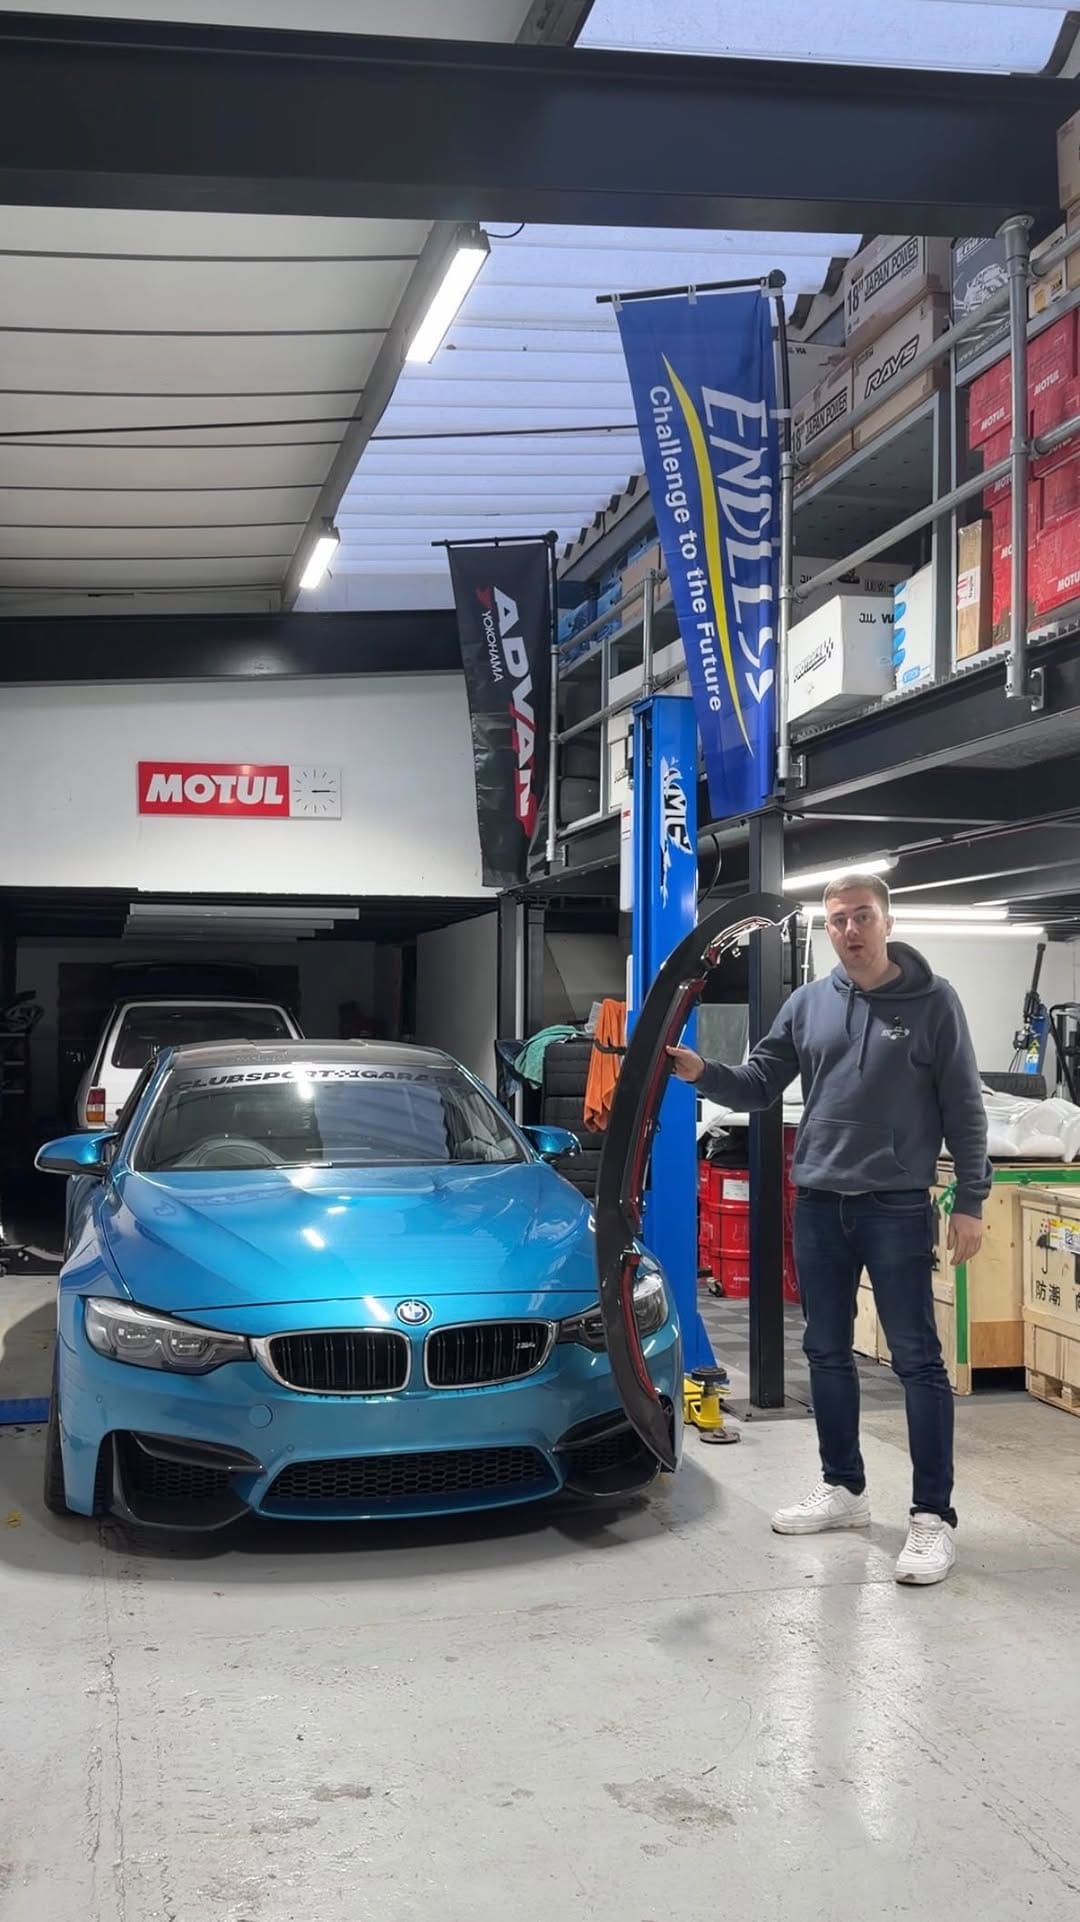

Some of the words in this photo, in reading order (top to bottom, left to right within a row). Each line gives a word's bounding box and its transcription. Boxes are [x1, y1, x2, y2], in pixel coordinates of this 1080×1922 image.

[864, 261, 890, 297] JAPAN
[891, 240, 919, 274] POWER
[864, 334, 920, 400] RAYS
[1033, 369, 1060, 397] MOTUL
[805, 408, 825, 441] JAPAN
[826, 392, 848, 423] POWER
[980, 407, 1005, 433] MOTUL
[648, 384, 692, 524] Challenge
[993, 473, 1012, 493] MOT
[677, 529, 699, 560] to
[686, 567, 709, 614] the
[1057, 570, 1080, 592] MOTU
[480, 609, 504, 683] YOKOHAMA
[695, 621, 723, 713] Future
[493, 586, 536, 818] ADVAN
[145, 773, 284, 805] MOTUL
[1035, 1279, 1061, 1307] 防潮
